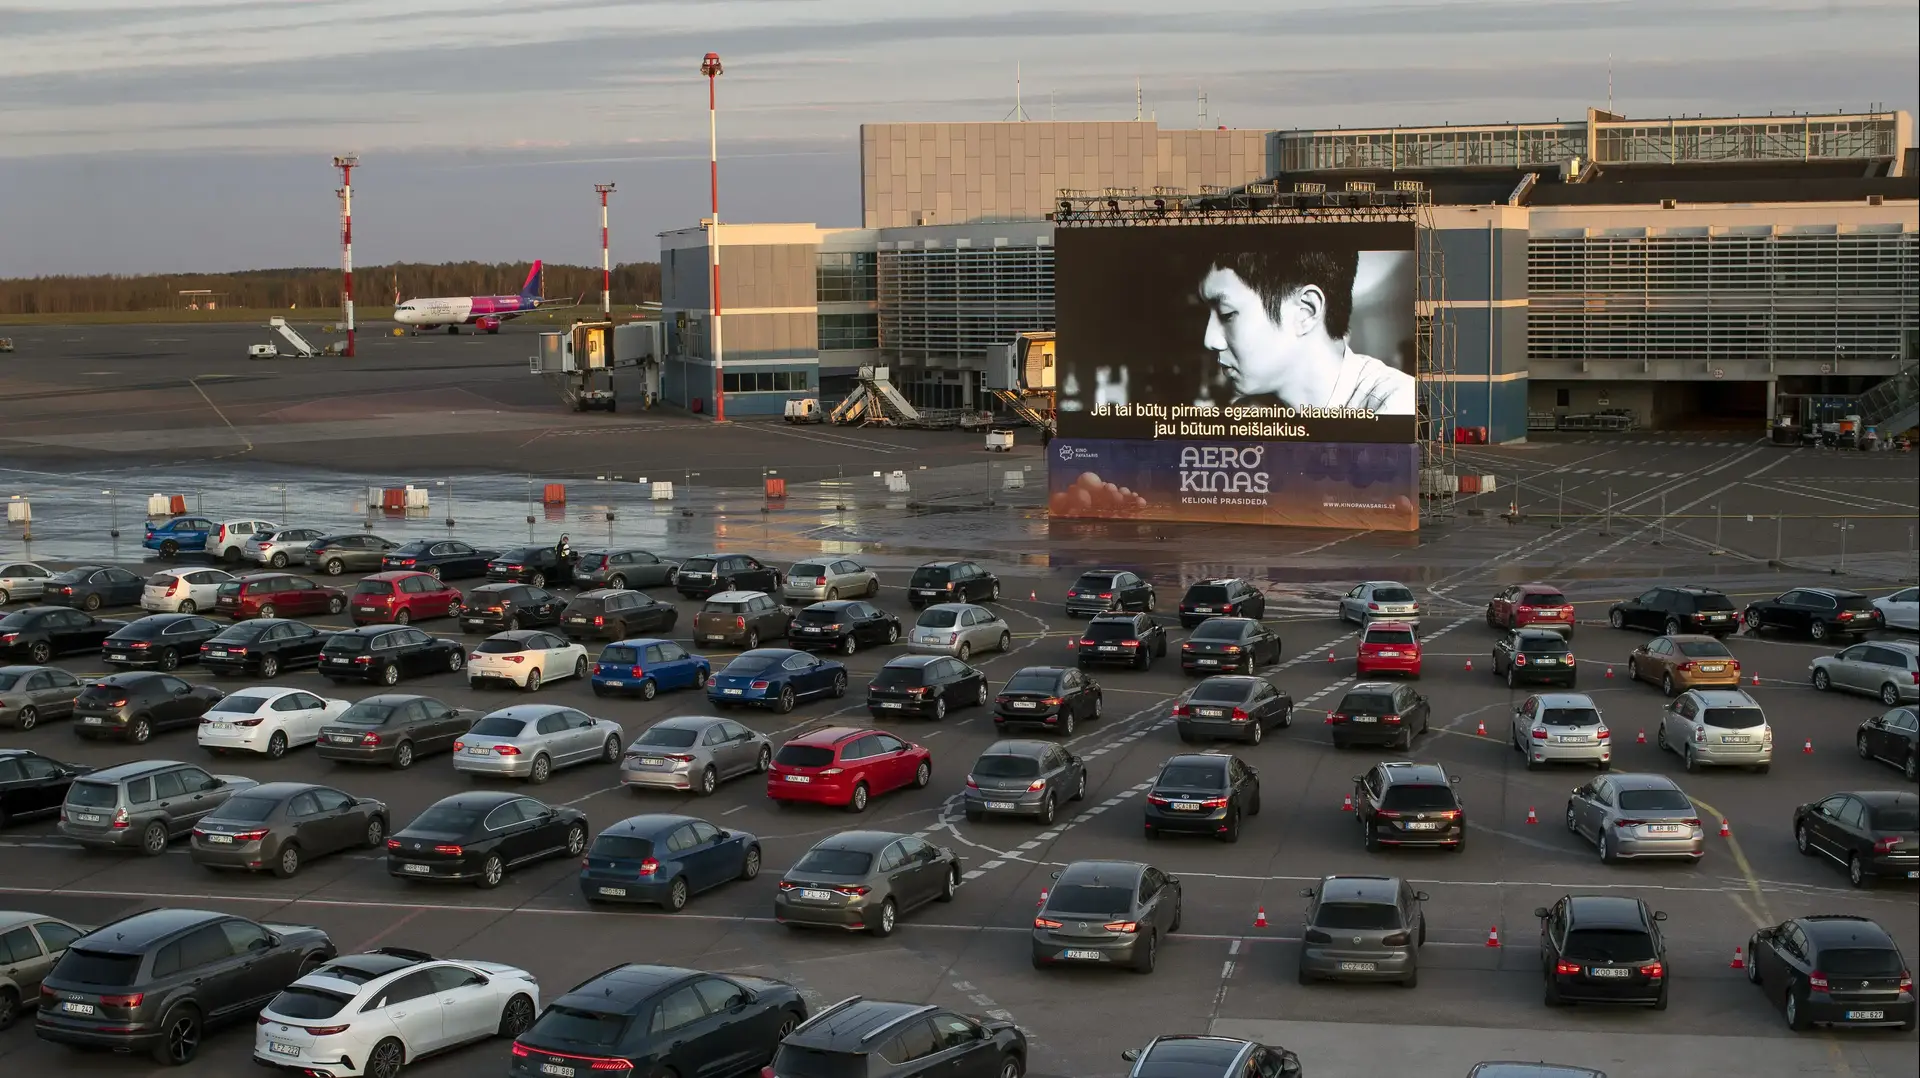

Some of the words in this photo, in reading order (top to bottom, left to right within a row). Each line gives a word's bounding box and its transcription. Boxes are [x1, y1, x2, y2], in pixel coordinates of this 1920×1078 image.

[1090, 403, 1111, 417] Jei
[1115, 403, 1132, 417] tai
[1136, 403, 1168, 421] būtų
[1171, 404, 1220, 421] pirmas
[1224, 405, 1296, 421] egzamino
[1300, 404, 1379, 421] klausimas,
[1153, 421, 1176, 438] jau
[1180, 422, 1226, 436] būtum
[1230, 422, 1310, 437] neišlaikius.
[1179, 471, 1269, 493] KINAS
[1181, 496, 1218, 504] KELIONĖ
[1220, 497, 1268, 505] PRASIDEDA
[543, 1063, 558, 1073] KTD
[561, 1067, 574, 1076] 989
